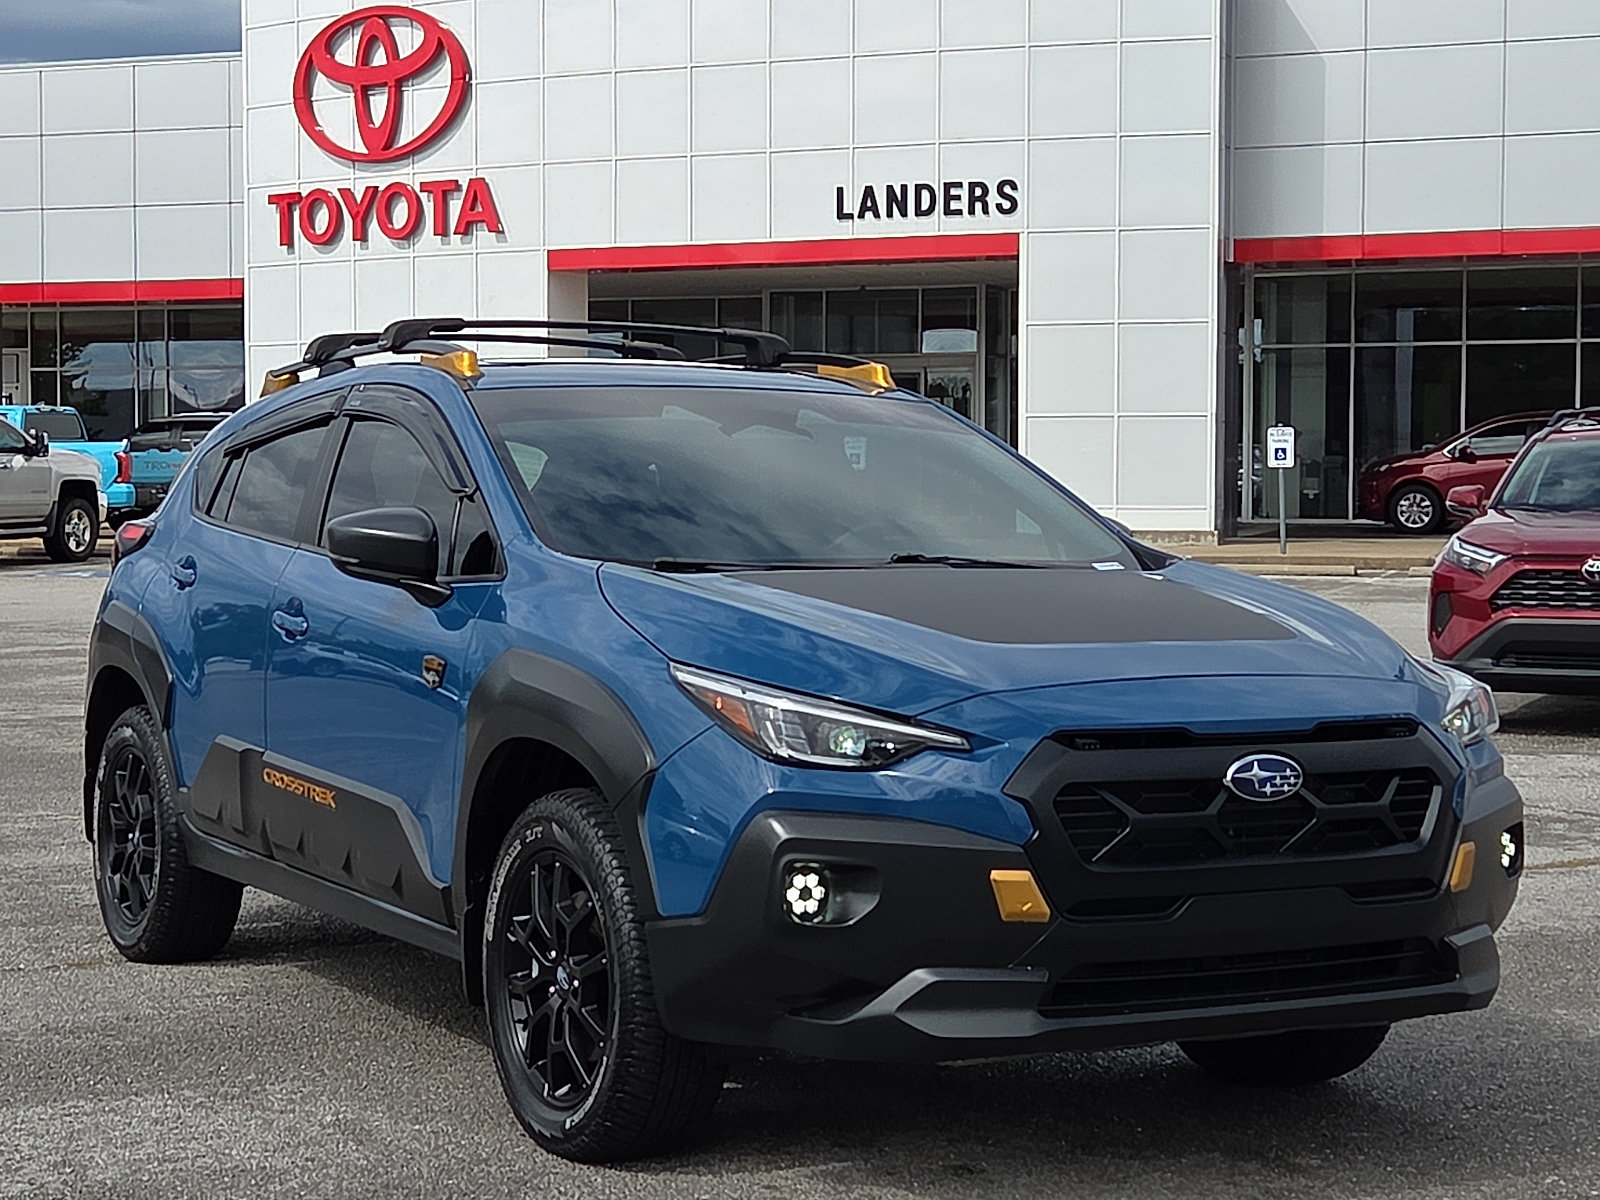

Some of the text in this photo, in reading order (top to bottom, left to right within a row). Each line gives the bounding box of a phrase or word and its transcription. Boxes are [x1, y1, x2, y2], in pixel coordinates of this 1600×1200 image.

[268, 177, 504, 247] TOYOTA
[836, 179, 1019, 220] LANDERS
[263, 767, 336, 809] CROSSTREK
